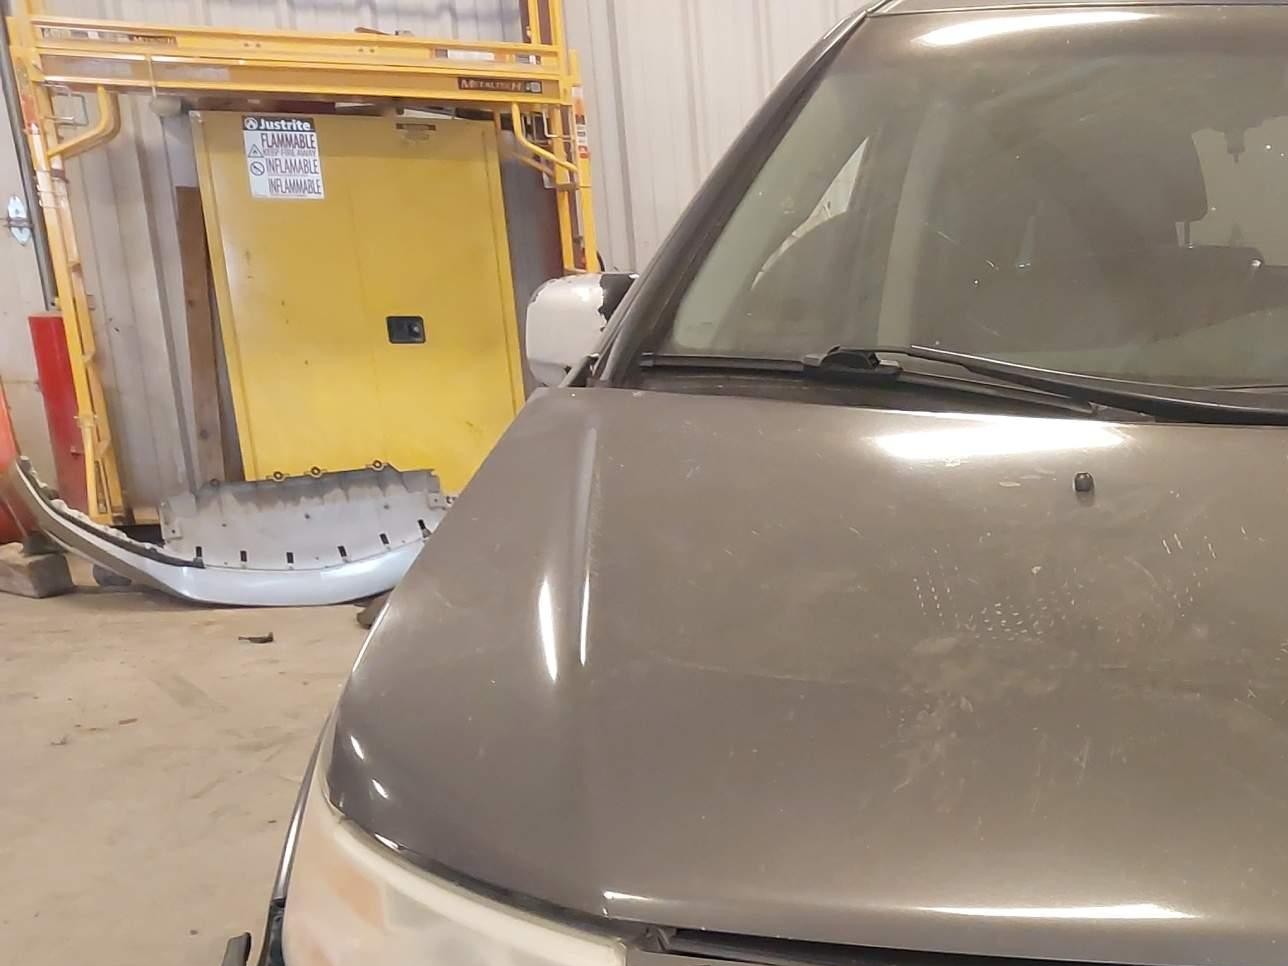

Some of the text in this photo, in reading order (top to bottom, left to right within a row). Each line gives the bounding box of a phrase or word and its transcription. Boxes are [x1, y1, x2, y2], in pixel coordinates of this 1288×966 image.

[259, 118, 312, 131] Justrite
[260, 132, 317, 149] FLAMMABLE
[265, 157, 320, 175] INFLAMABLE
[268, 177, 322, 195] INFLAMMABLE
